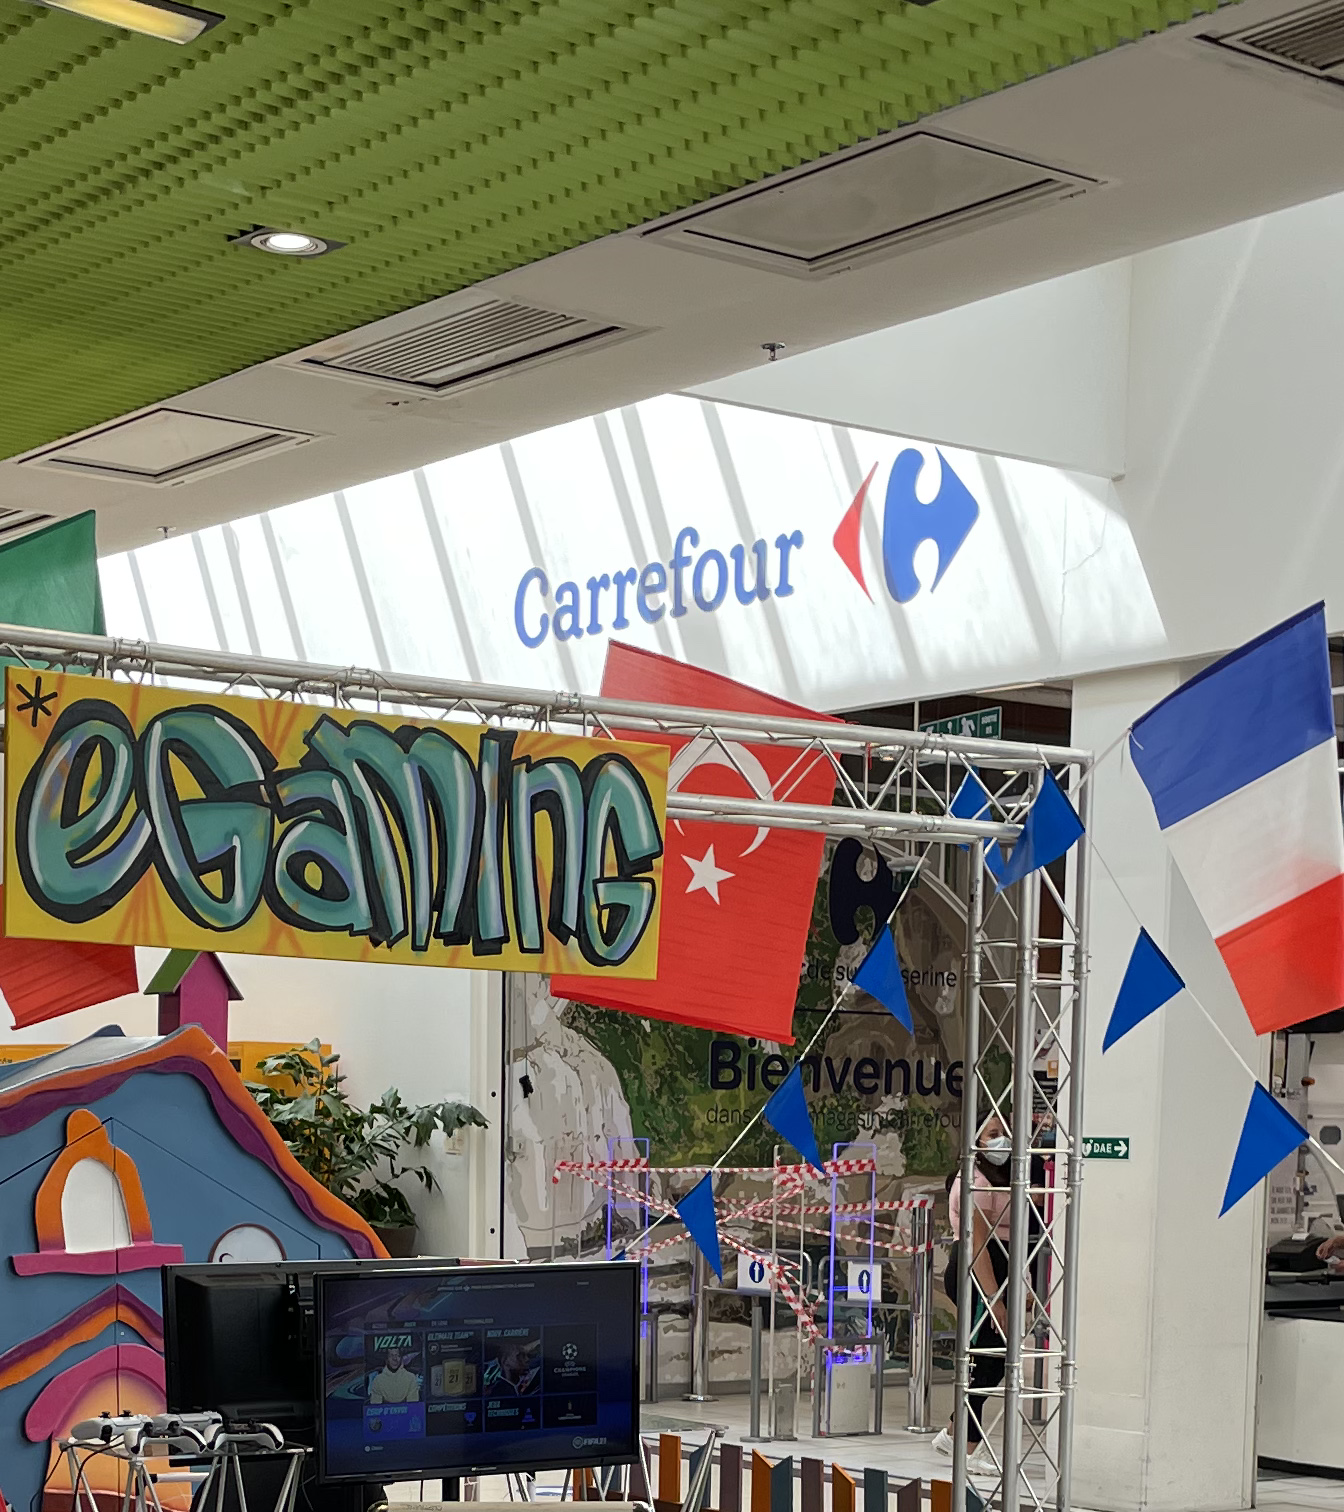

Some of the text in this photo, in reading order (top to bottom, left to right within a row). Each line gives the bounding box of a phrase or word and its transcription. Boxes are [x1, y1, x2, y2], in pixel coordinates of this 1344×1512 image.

[514, 526, 804, 649] Carrefour
[709, 1037, 963, 1098] Bienvenue
[706, 1106, 752, 1125] dans
[887, 1109, 962, 1129] Carrefou
[1093, 1143, 1113, 1154] DAE
[374, 1335, 412, 1352] VOLTA
